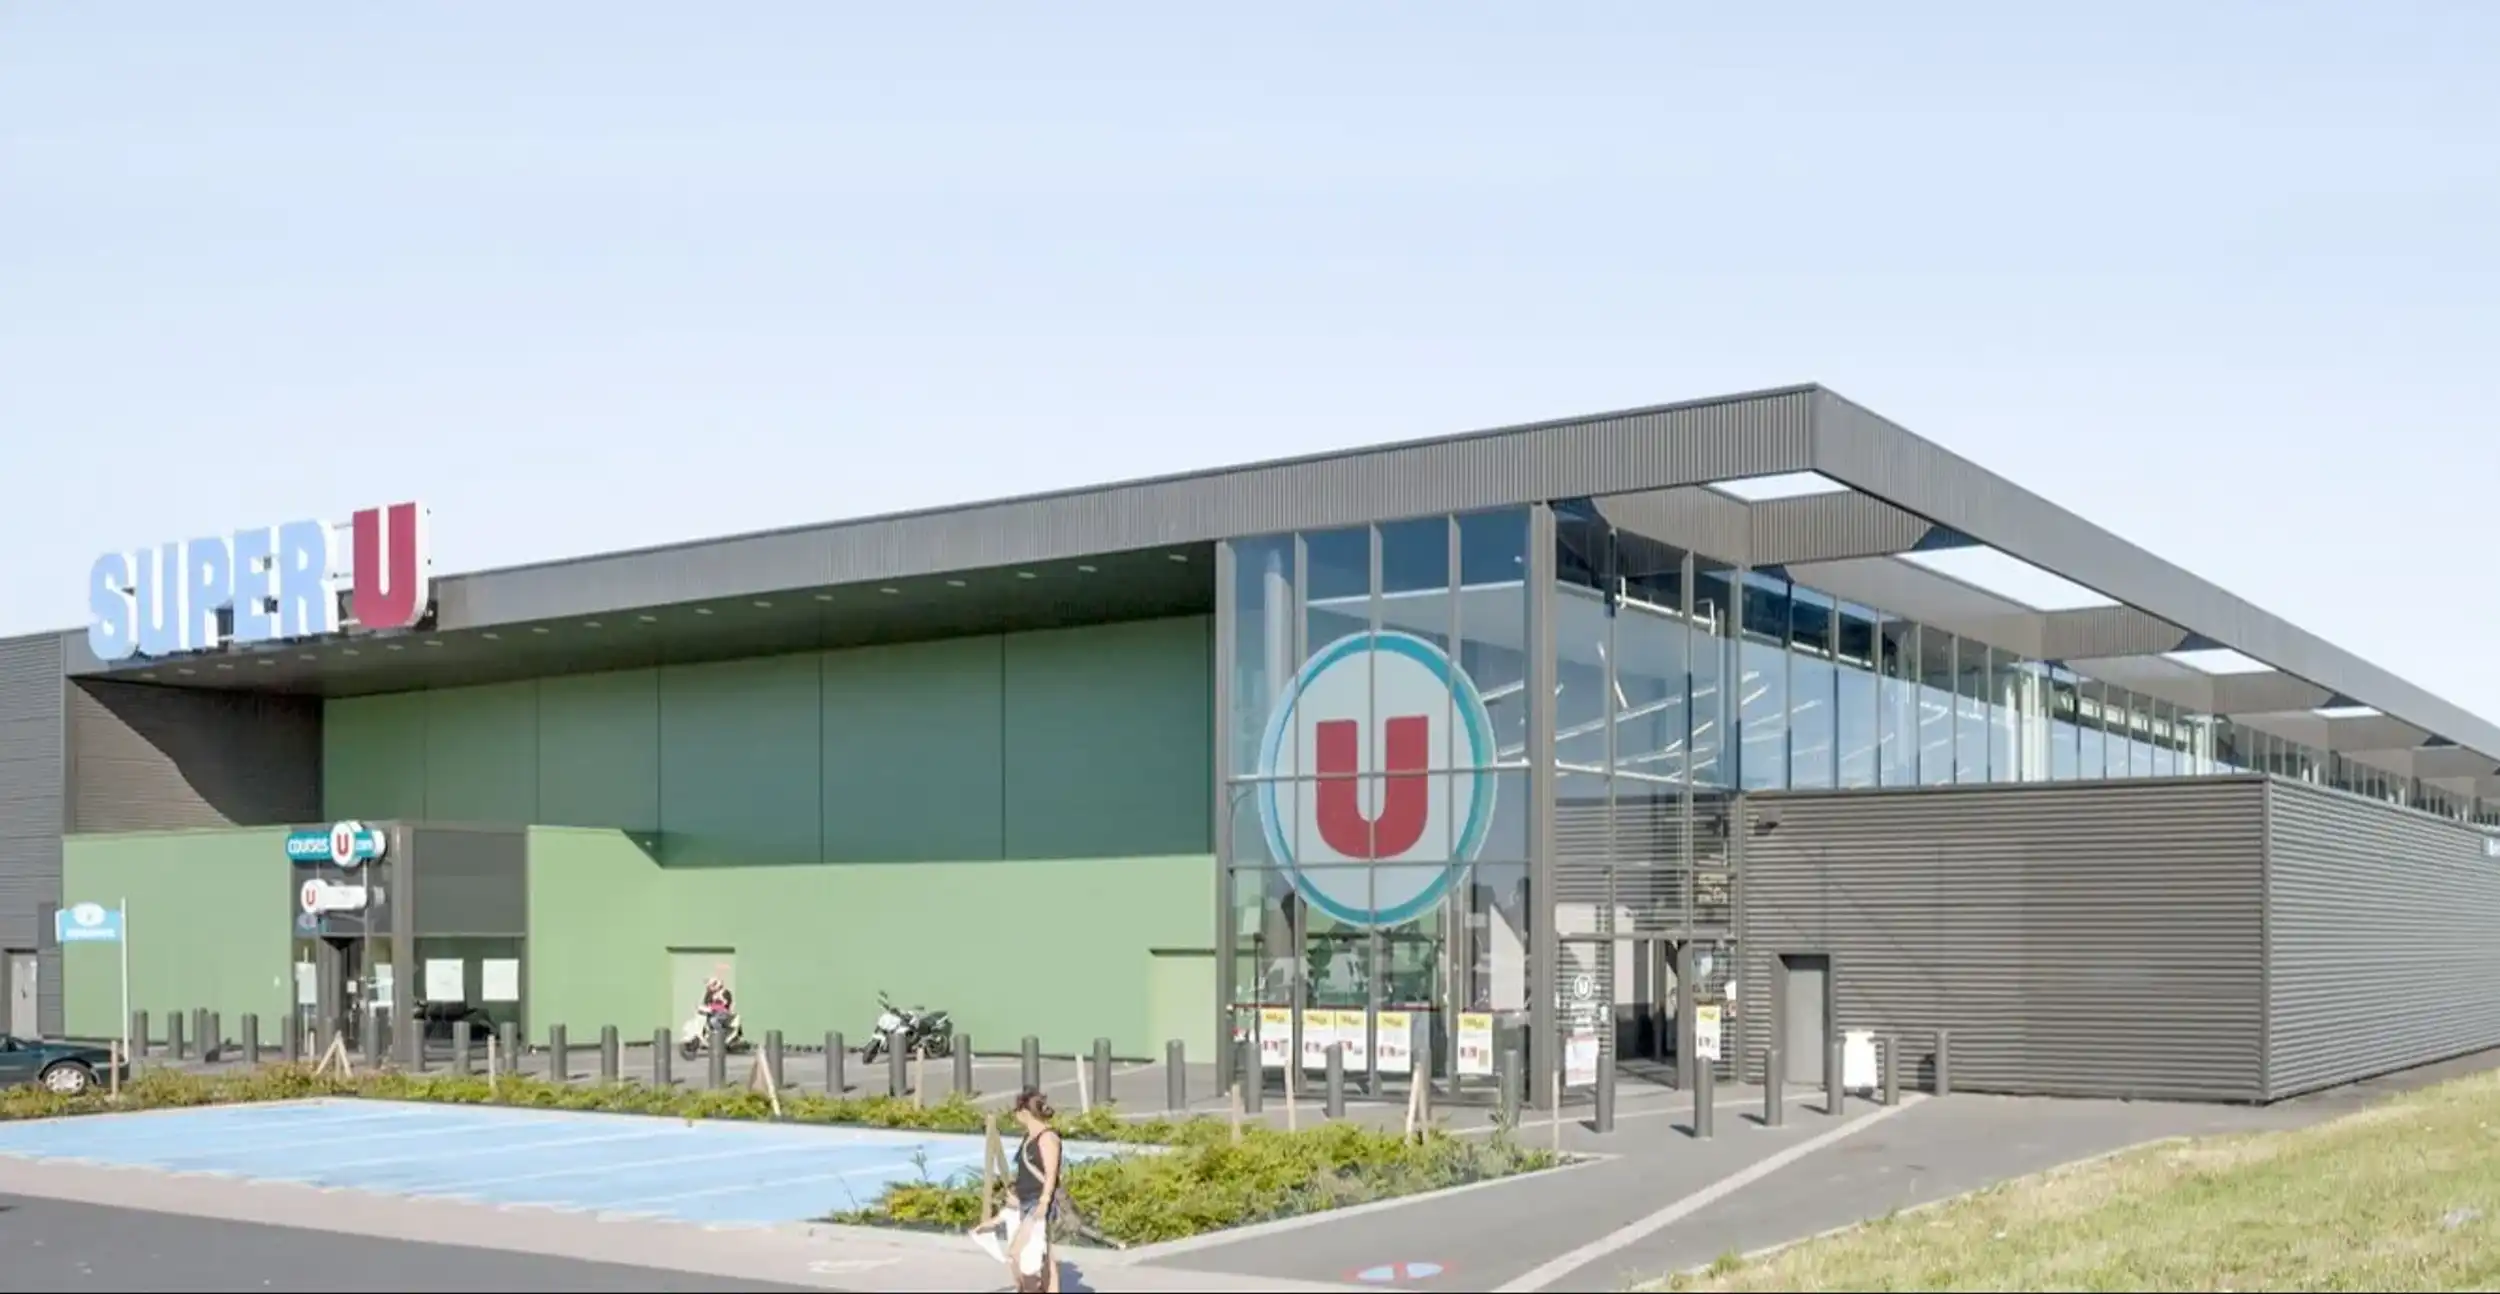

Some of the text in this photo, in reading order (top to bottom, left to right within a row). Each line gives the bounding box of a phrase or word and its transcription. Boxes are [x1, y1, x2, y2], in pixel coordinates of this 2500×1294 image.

[88, 502, 418, 660] SUPER U
[1315, 714, 1429, 861] U
[335, 832, 350, 856] U
[305, 888, 316, 906] U
